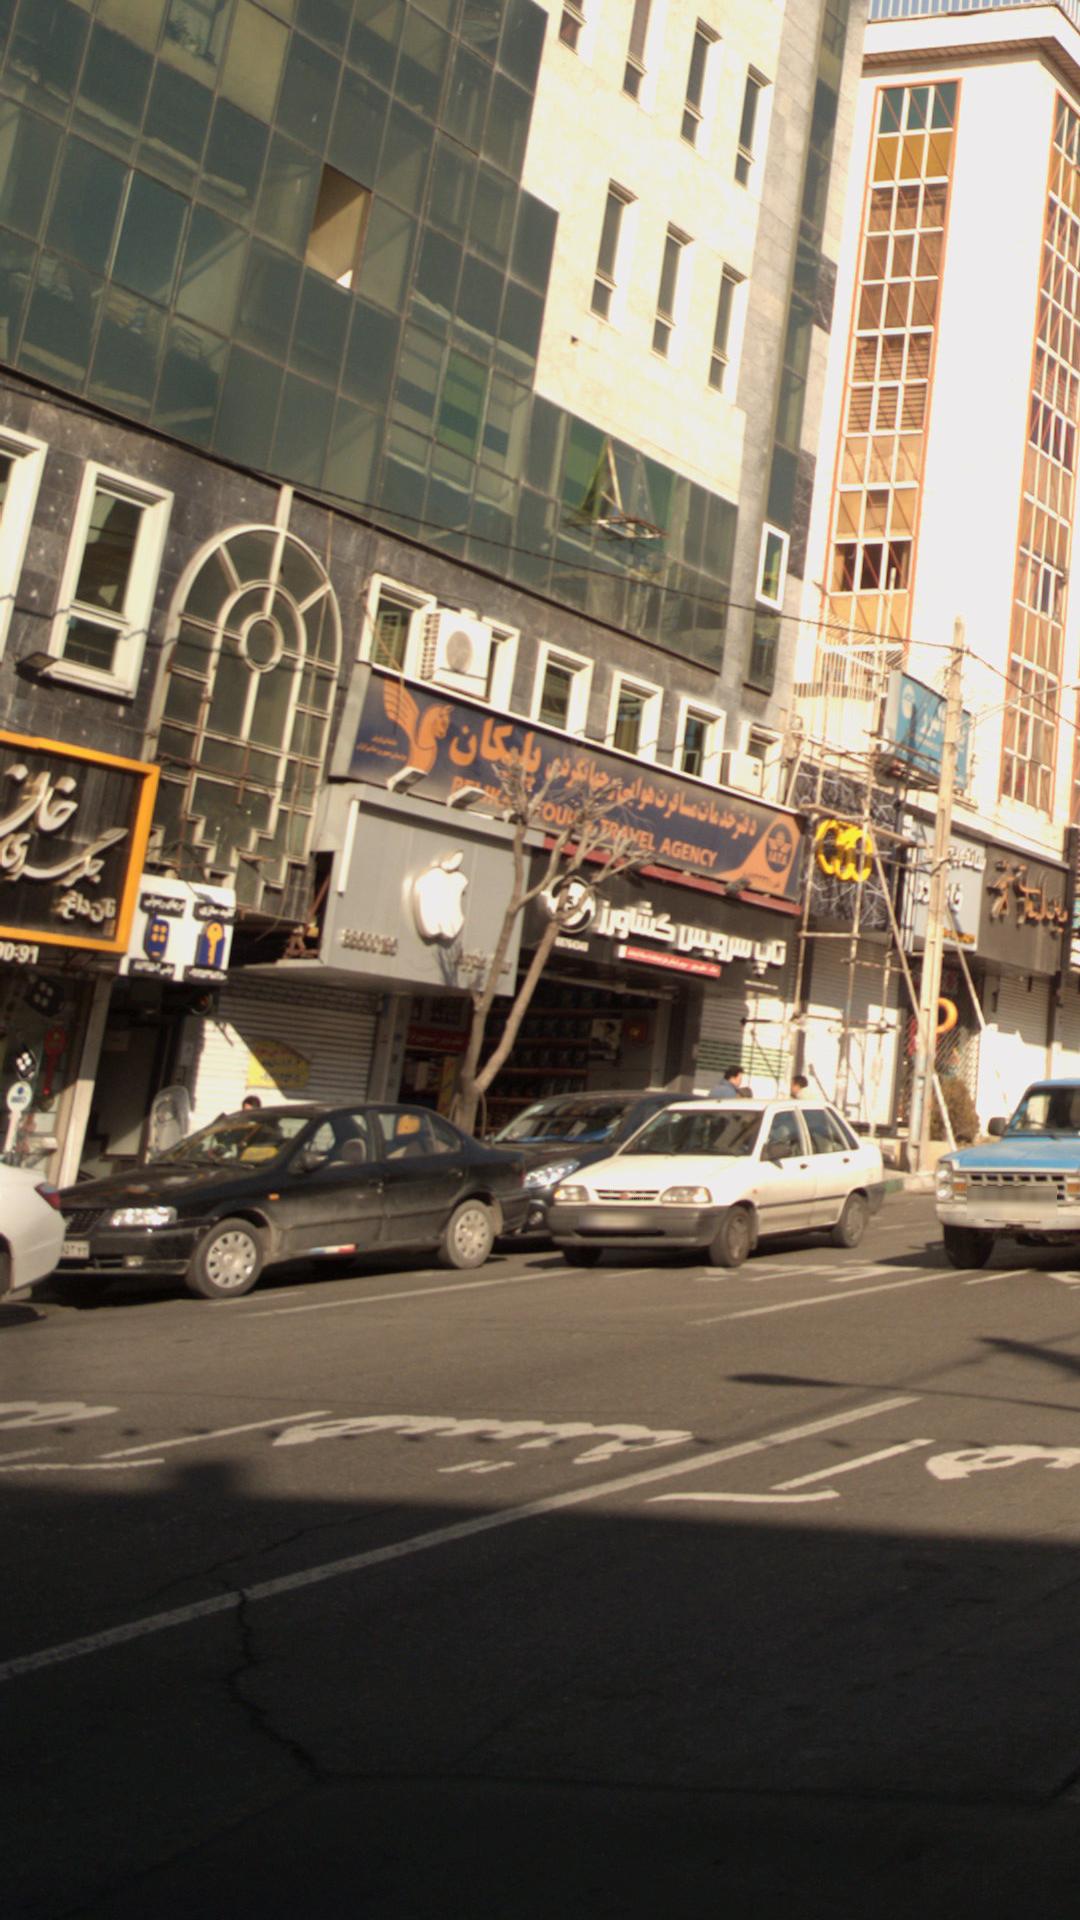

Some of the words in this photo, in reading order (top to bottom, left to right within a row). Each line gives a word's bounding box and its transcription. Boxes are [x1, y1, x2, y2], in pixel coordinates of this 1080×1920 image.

[449, 717, 541, 791] پلیکان
[537, 799, 578, 827] OUR
[659, 838, 718, 868] AGENCY
[597, 901, 676, 942] کشاورز
[677, 923, 751, 963] سرویس
[754, 938, 787, 975] تاپ
